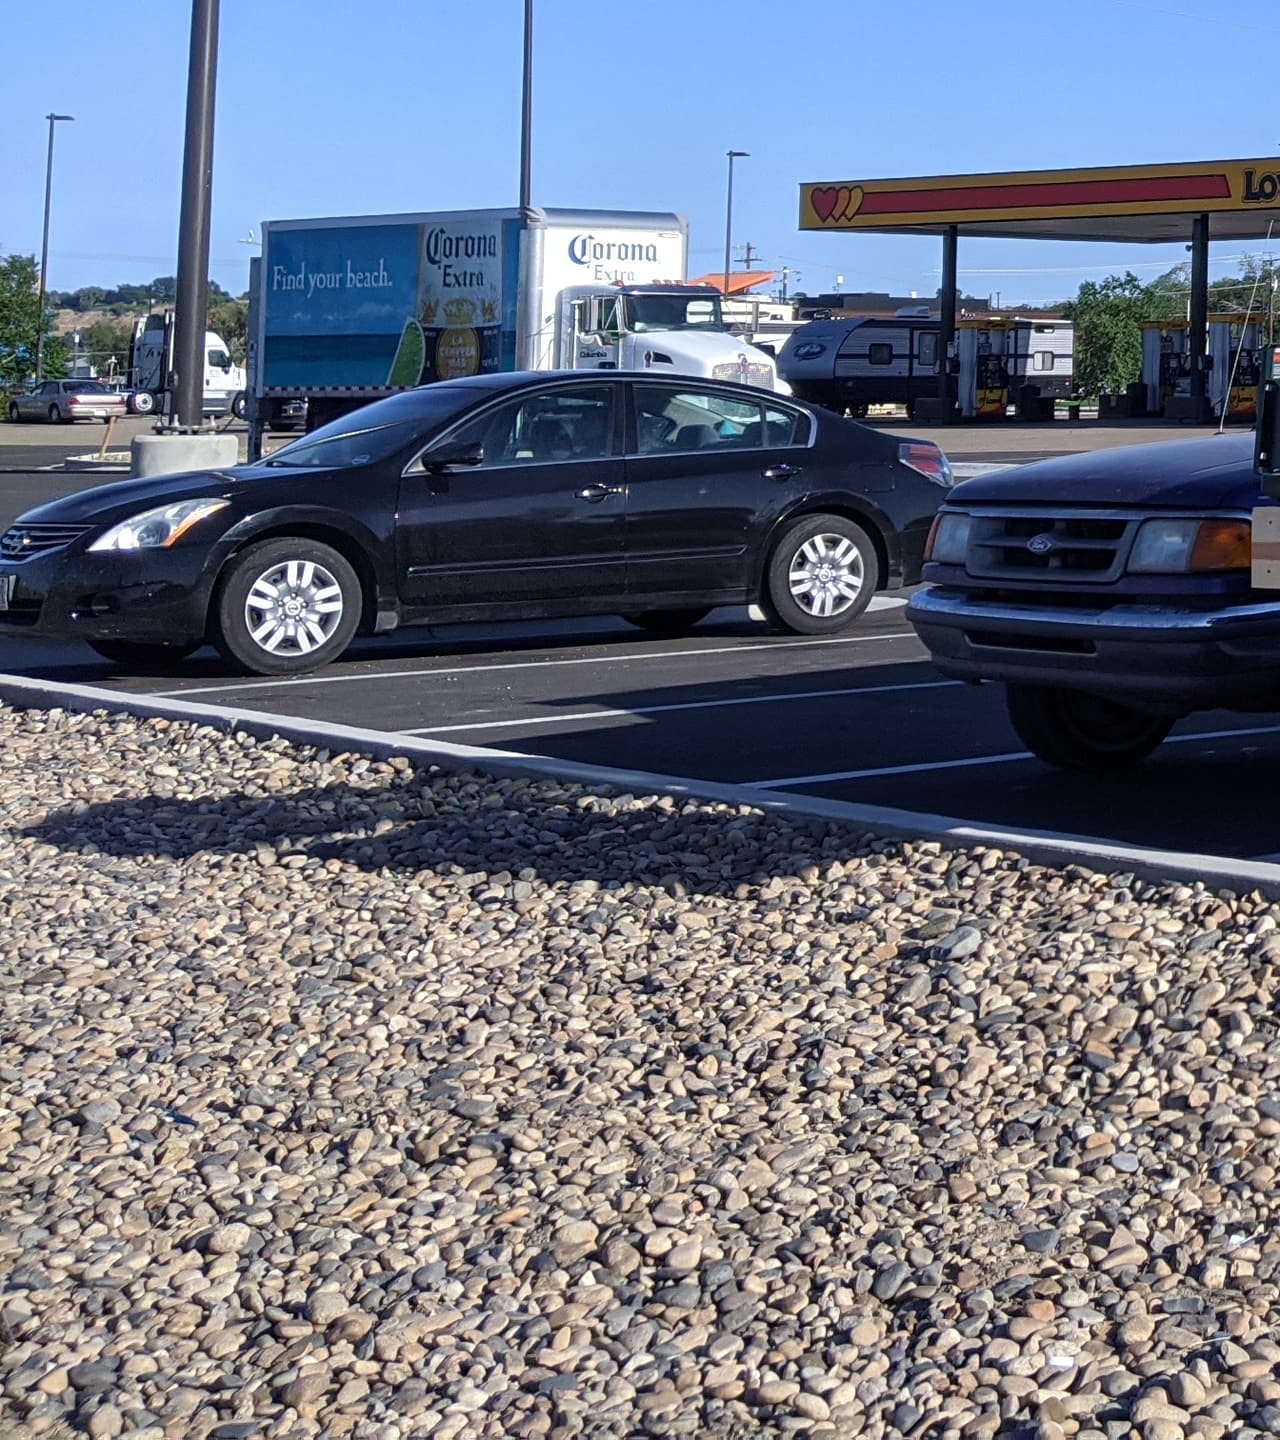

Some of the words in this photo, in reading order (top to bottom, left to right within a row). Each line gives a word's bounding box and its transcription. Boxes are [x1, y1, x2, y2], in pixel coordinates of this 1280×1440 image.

[427, 227, 496, 265] Corona
[568, 234, 657, 265] Corona
[272, 262, 304, 290] Find
[308, 271, 342, 298] your
[346, 258, 392, 288] beach.
[443, 264, 483, 288] Extra
[594, 264, 635, 281] Extra
